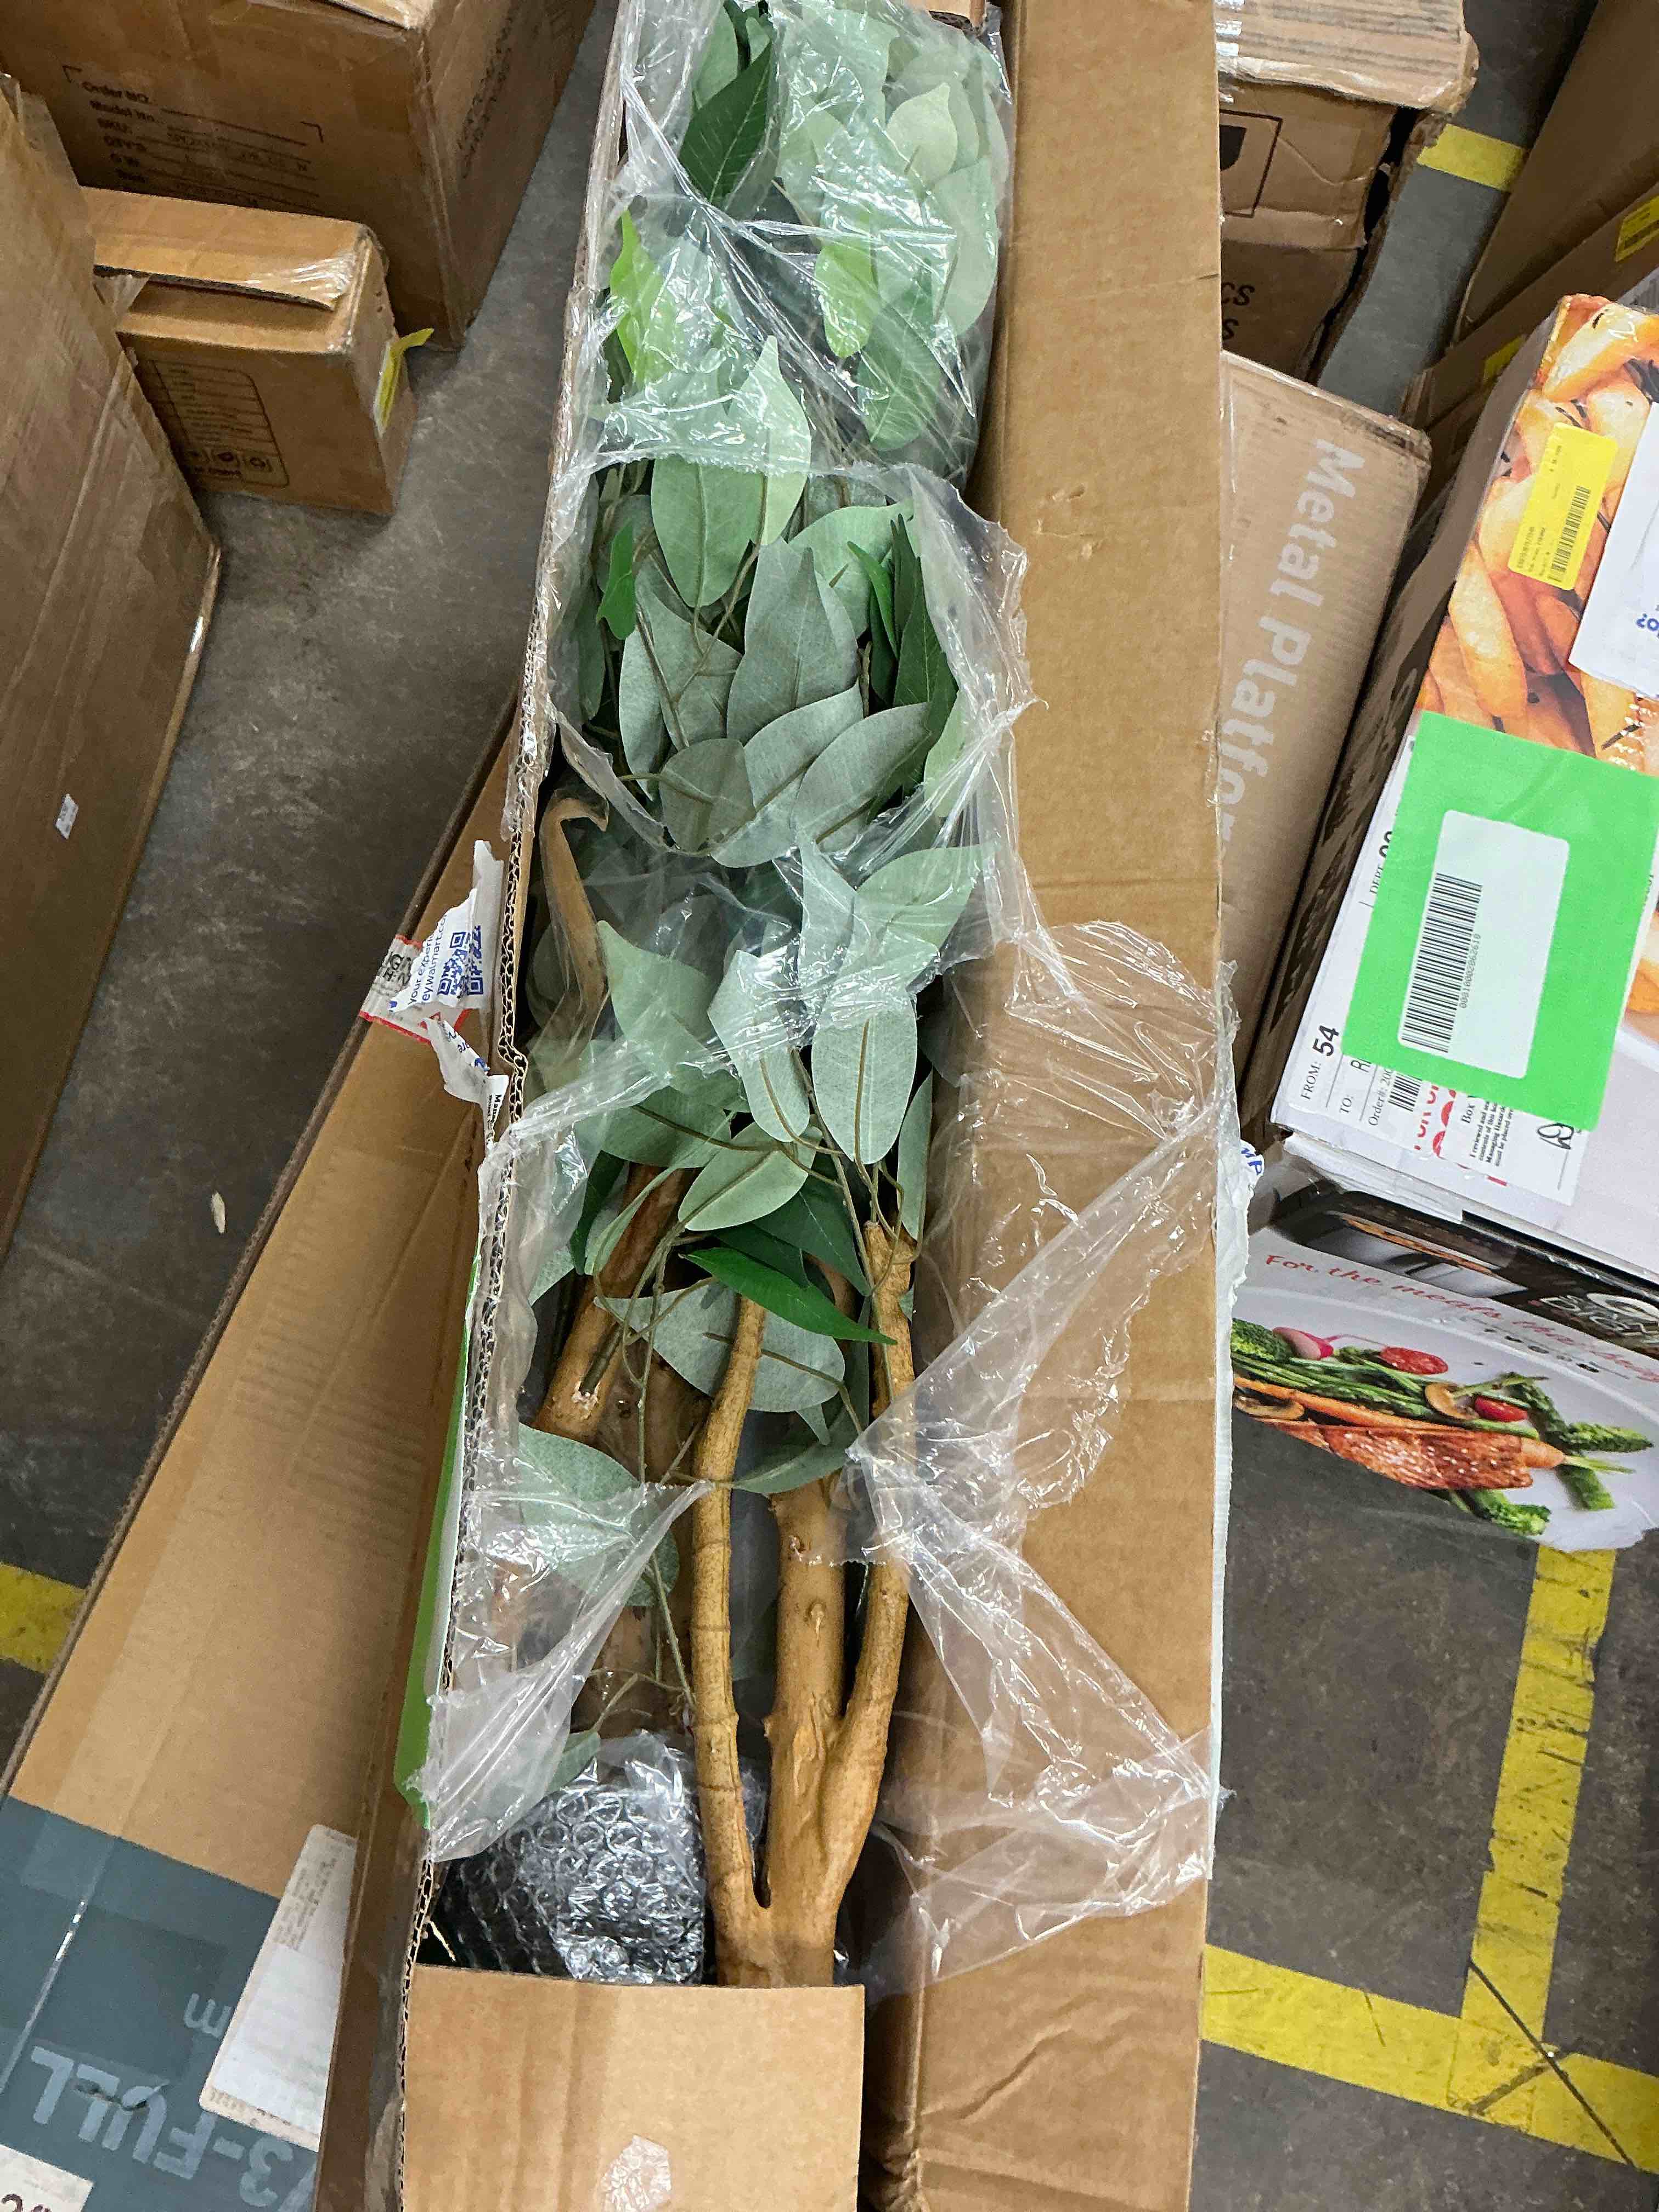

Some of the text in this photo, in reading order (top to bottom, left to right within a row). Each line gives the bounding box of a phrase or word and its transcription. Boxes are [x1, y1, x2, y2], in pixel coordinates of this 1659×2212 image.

[1269, 438, 1365, 607] Metal
[408, 978, 421, 1005] your
[1301, 1025, 1339, 1100] FROM: 54
[1339, 1094, 1353, 1115] TO:
[1368, 1085, 1388, 1127] Order#:
[1462, 1104, 1475, 1125] Box
[1265, 1254, 1314, 1271] For
[1329, 1266, 1381, 1286] the
